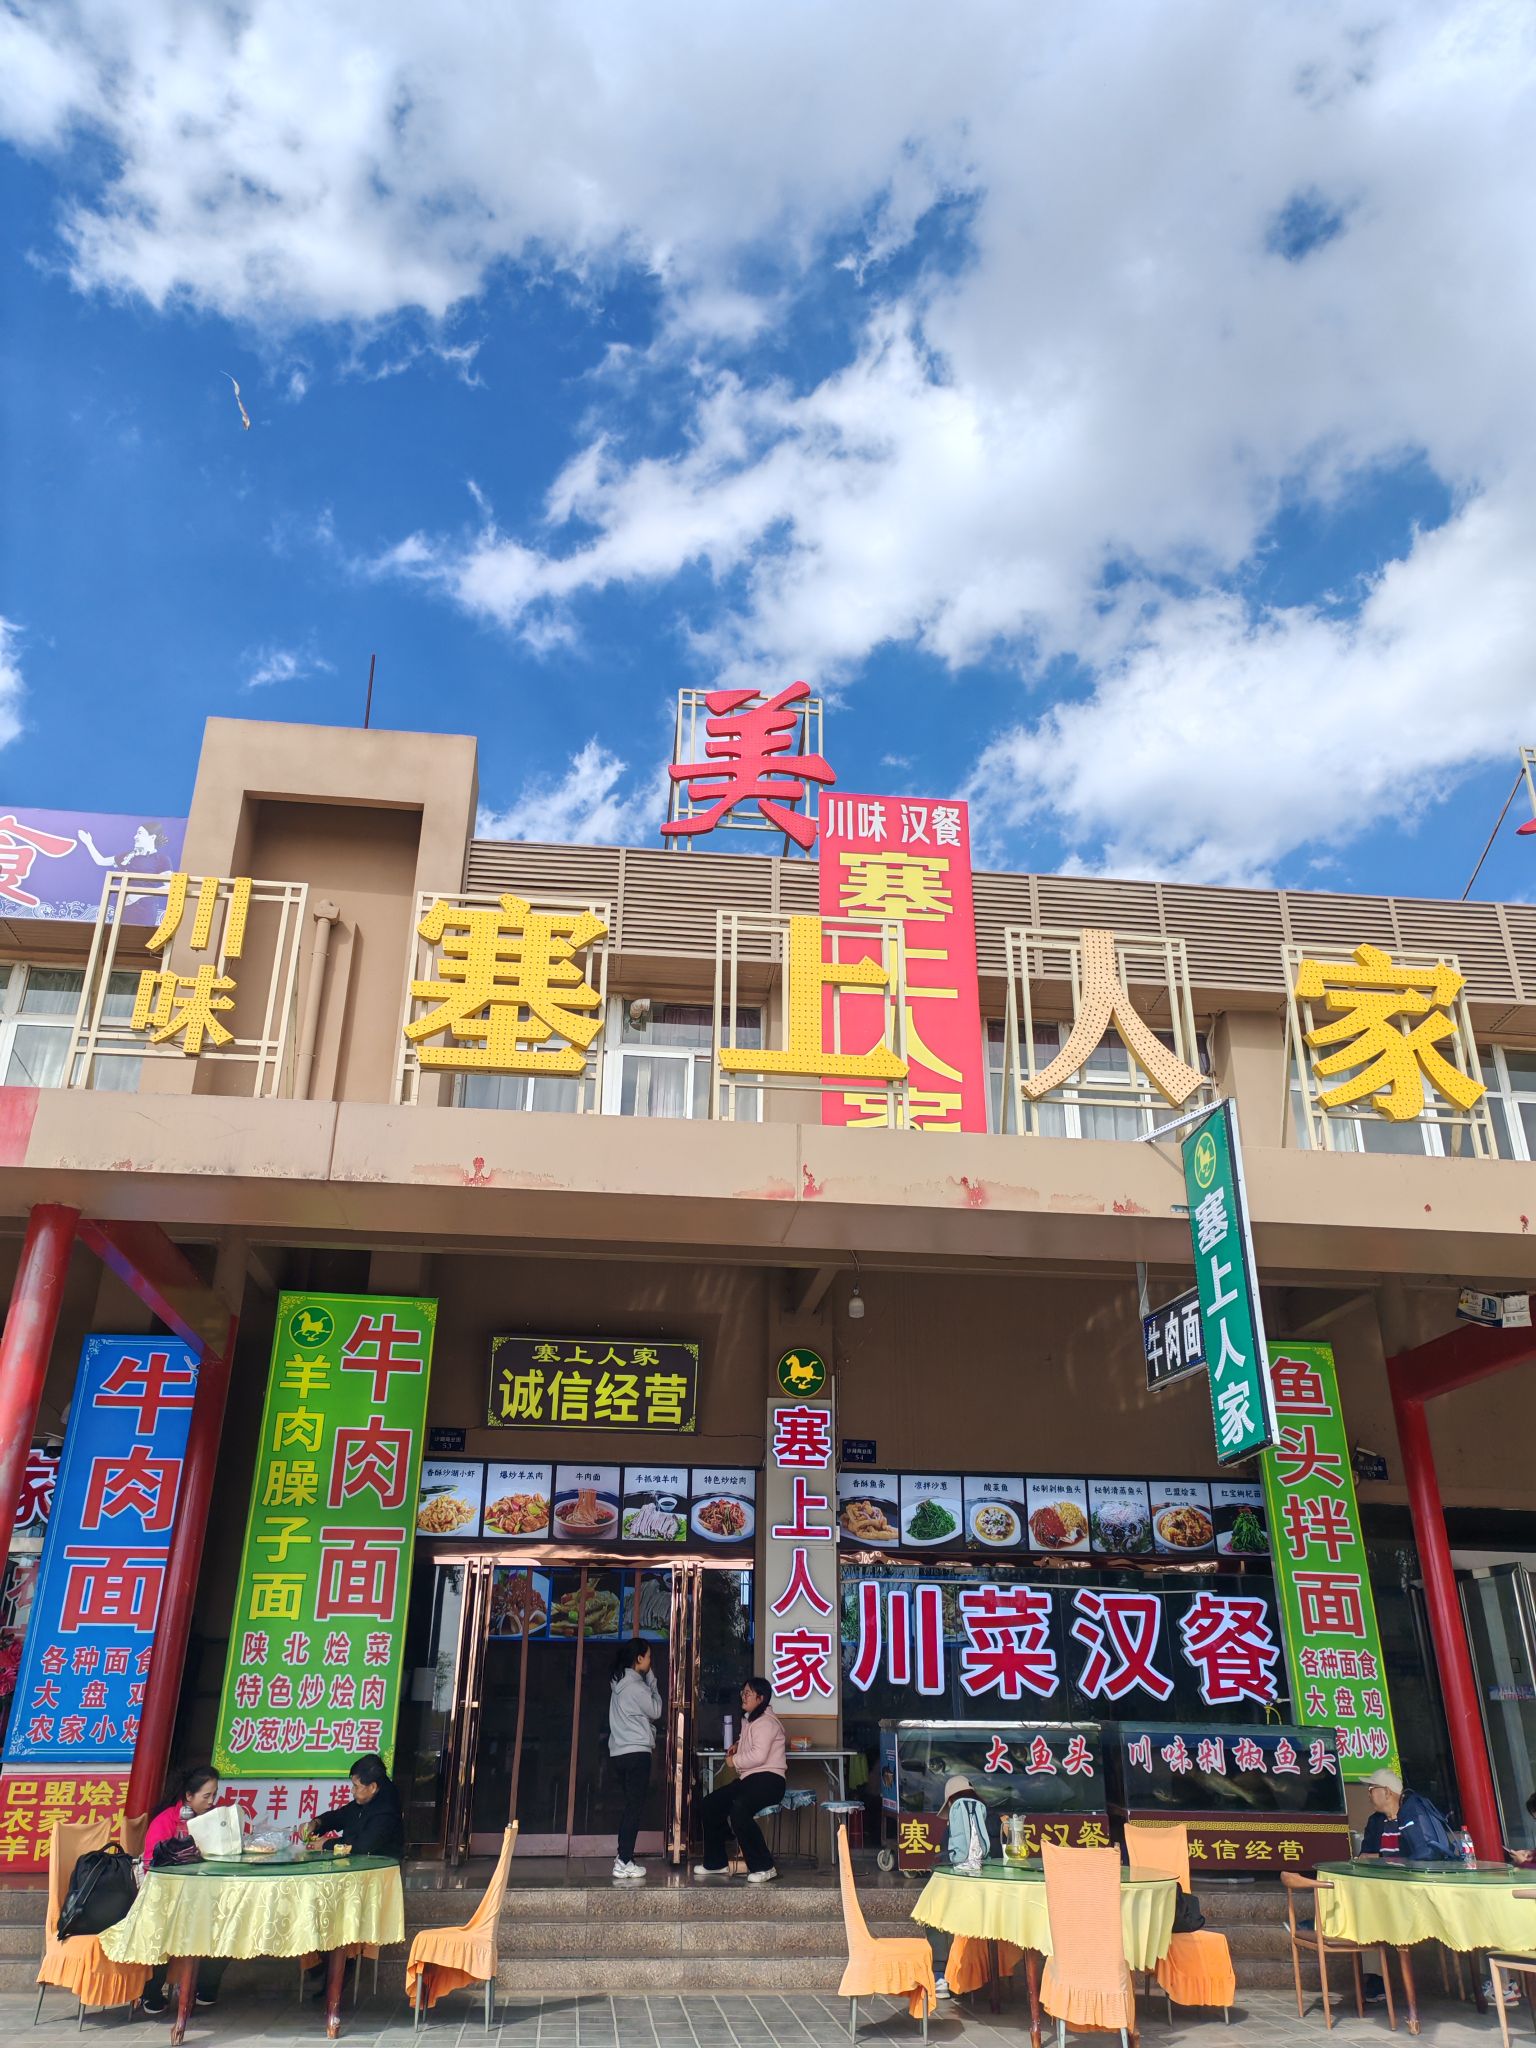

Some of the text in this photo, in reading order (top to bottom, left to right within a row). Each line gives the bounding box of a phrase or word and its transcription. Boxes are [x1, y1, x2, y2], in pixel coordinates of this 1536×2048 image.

[660, 680, 837, 851] 美
[826, 798, 961, 847] 川味 汉餐
[130, 872, 253, 1056] 川味
[402, 892, 1488, 1122] 塞上人家
[1145, 1298, 1204, 1377] 牛肉面
[1194, 1186, 1256, 1448] 塞上人家
[531, 1343, 660, 1367] 塞上人家
[498, 1367, 688, 1426] 诚信经营
[247, 1353, 332, 1621] 羊肉臊子面
[314, 1313, 424, 1623] 牛肉面
[575, 1472, 601, 1482] 牛肉面
[983, 1482, 1009, 1493] 酸菜鱼
[57, 1352, 196, 1634] 牛肉面
[1164, 1488, 1198, 1498] 巴盟烩菜
[1269, 1354, 1368, 1640] 鱼头拌面
[770, 1404, 835, 1702] 塞上人家
[241, 1633, 392, 1666] 陕北烩菜
[848, 1580, 1282, 1706] 川菜汉餐
[1299, 1647, 1379, 1681] 各种面食
[236, 1674, 388, 1709] 特色炒烩肉
[1306, 1685, 1385, 1722] 大盘鸡
[229, 1718, 383, 1754] 沙葱炒土鸡蛋
[983, 1734, 1095, 1778] 大鱼头
[1128, 1735, 1338, 1777] 川味剁椒鱼头
[1335, 1726, 1389, 1760] 家小炒
